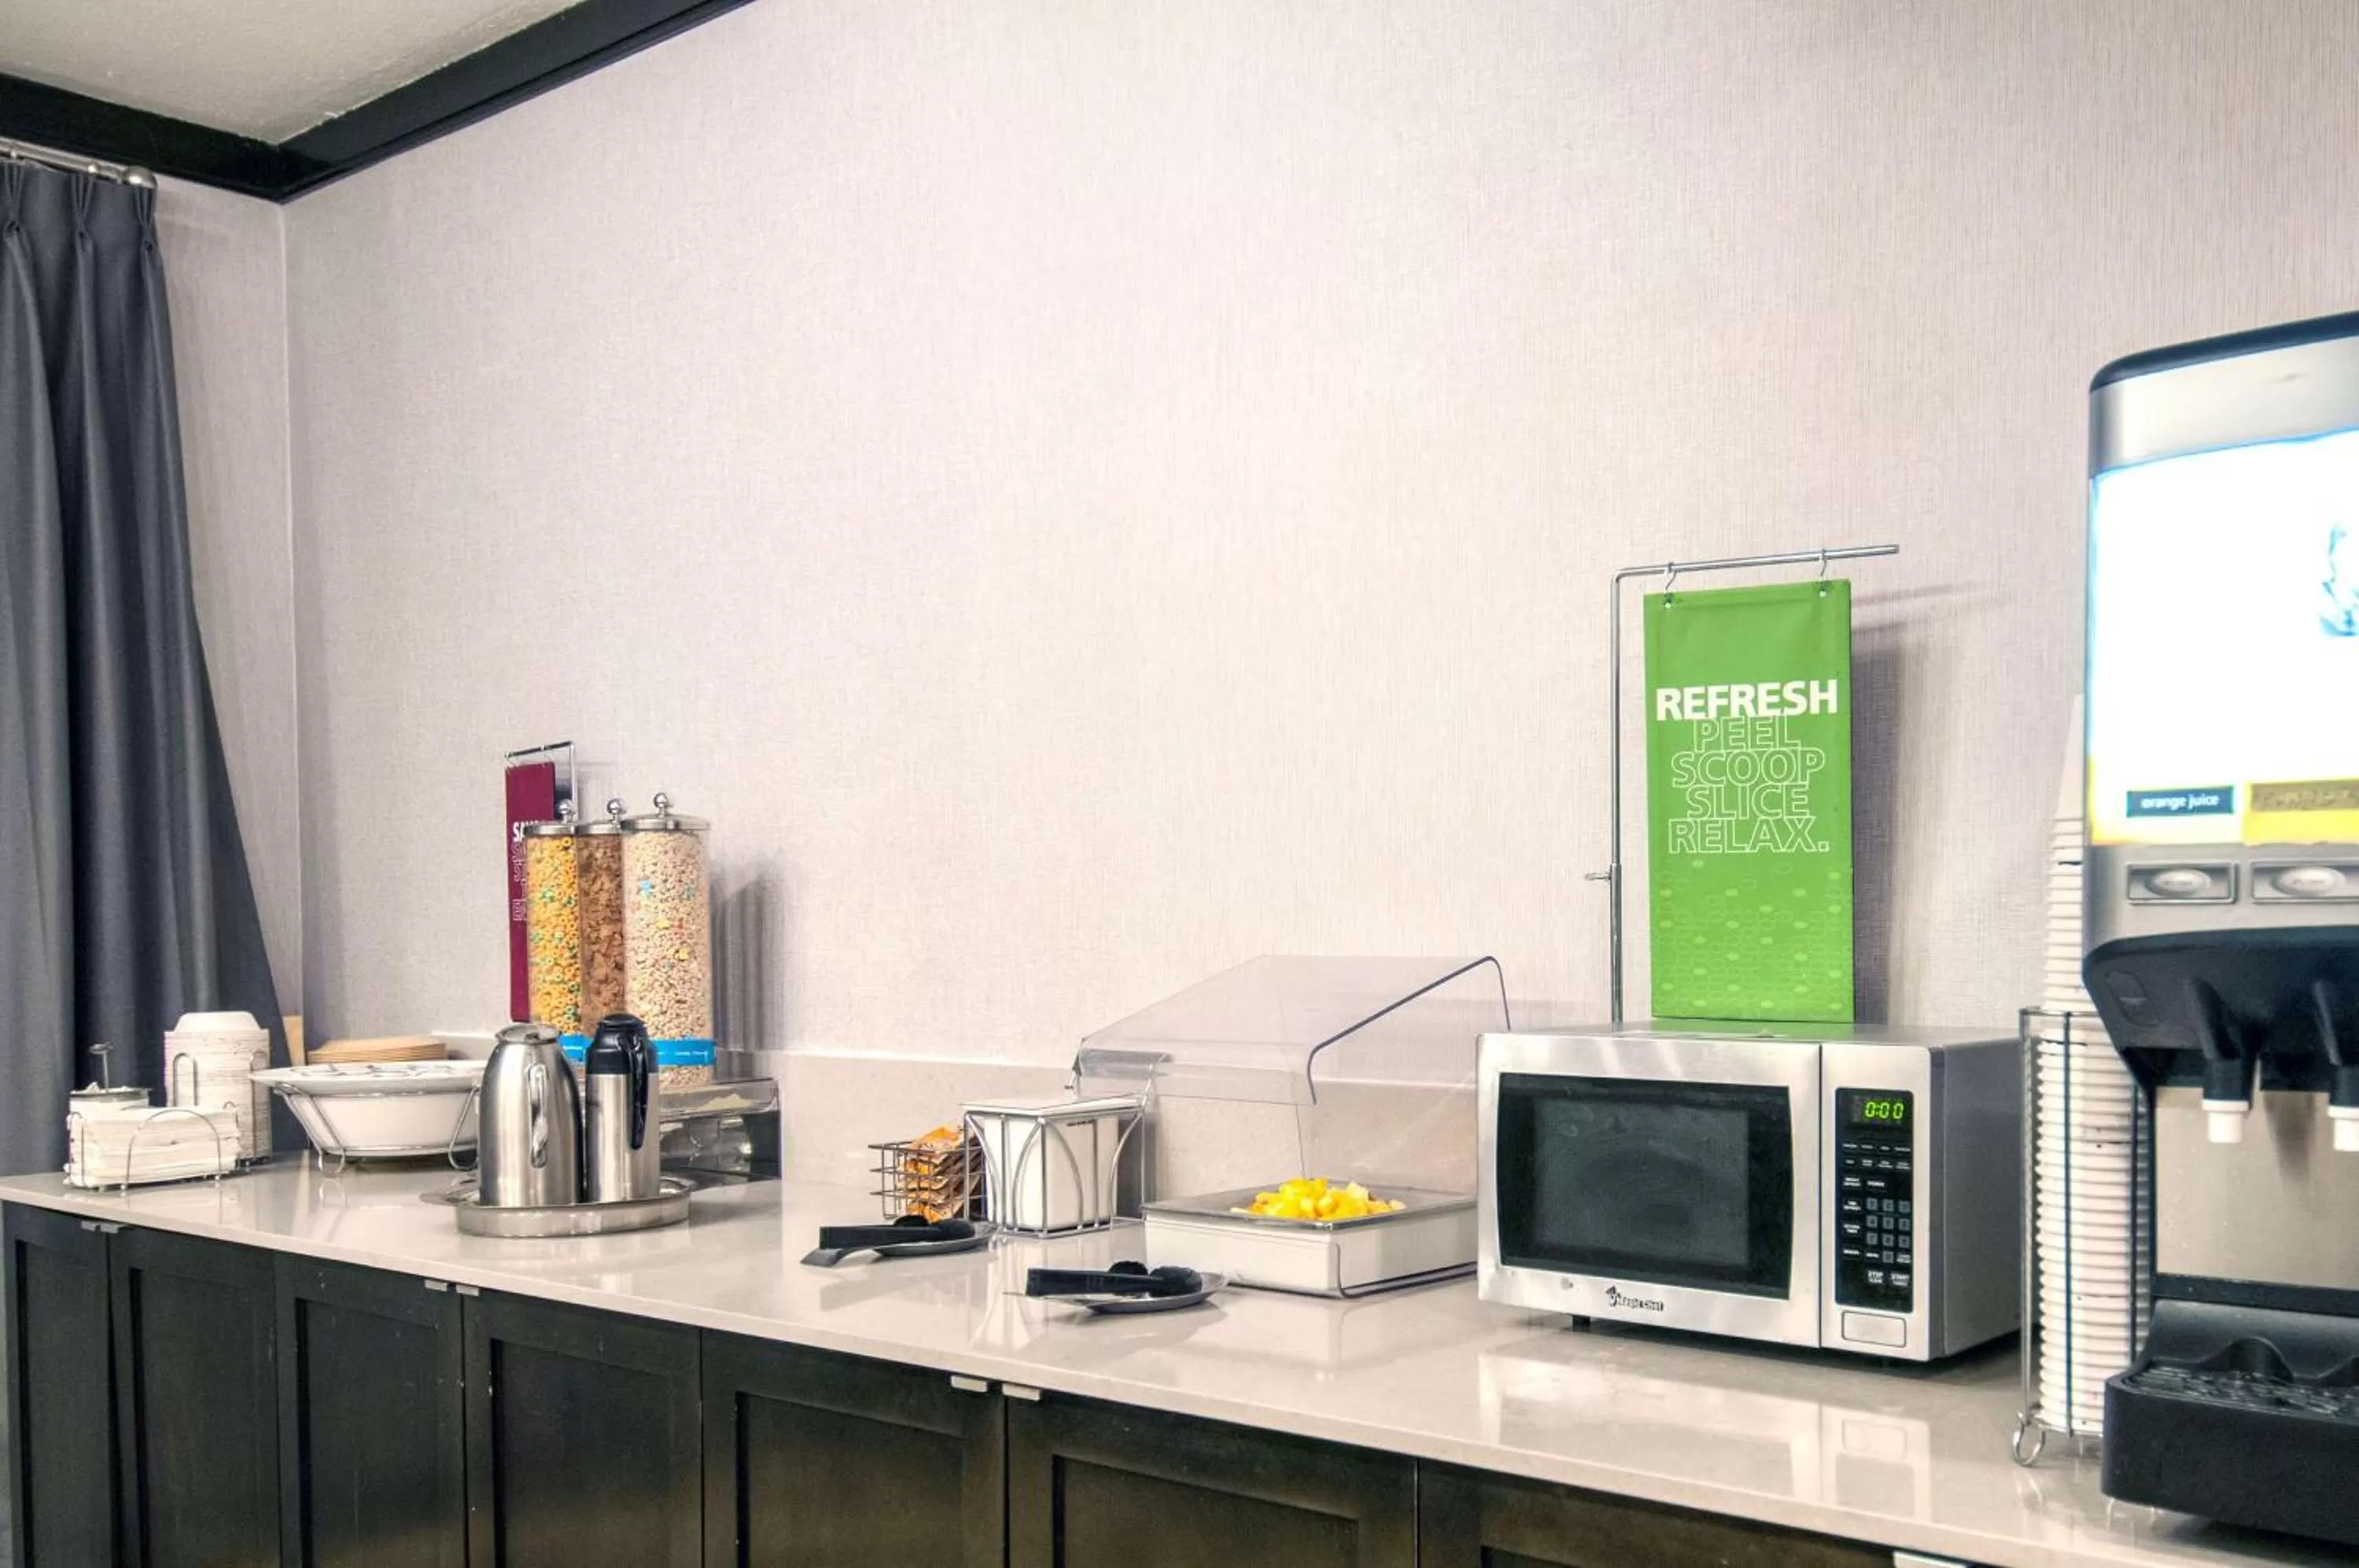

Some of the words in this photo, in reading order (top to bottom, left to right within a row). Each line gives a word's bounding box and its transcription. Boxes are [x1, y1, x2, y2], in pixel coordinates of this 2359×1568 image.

[1655, 679, 1838, 720] REFRESH
[1693, 711, 1801, 752] PEEL
[1671, 747, 1825, 788] SCOOP
[1686, 782, 1809, 820] SLICE
[2140, 797, 2187, 811] orange
[2188, 792, 2221, 810] juice
[1668, 815, 1831, 855] RELAX.
[1864, 1101, 1904, 1120] 0:00
